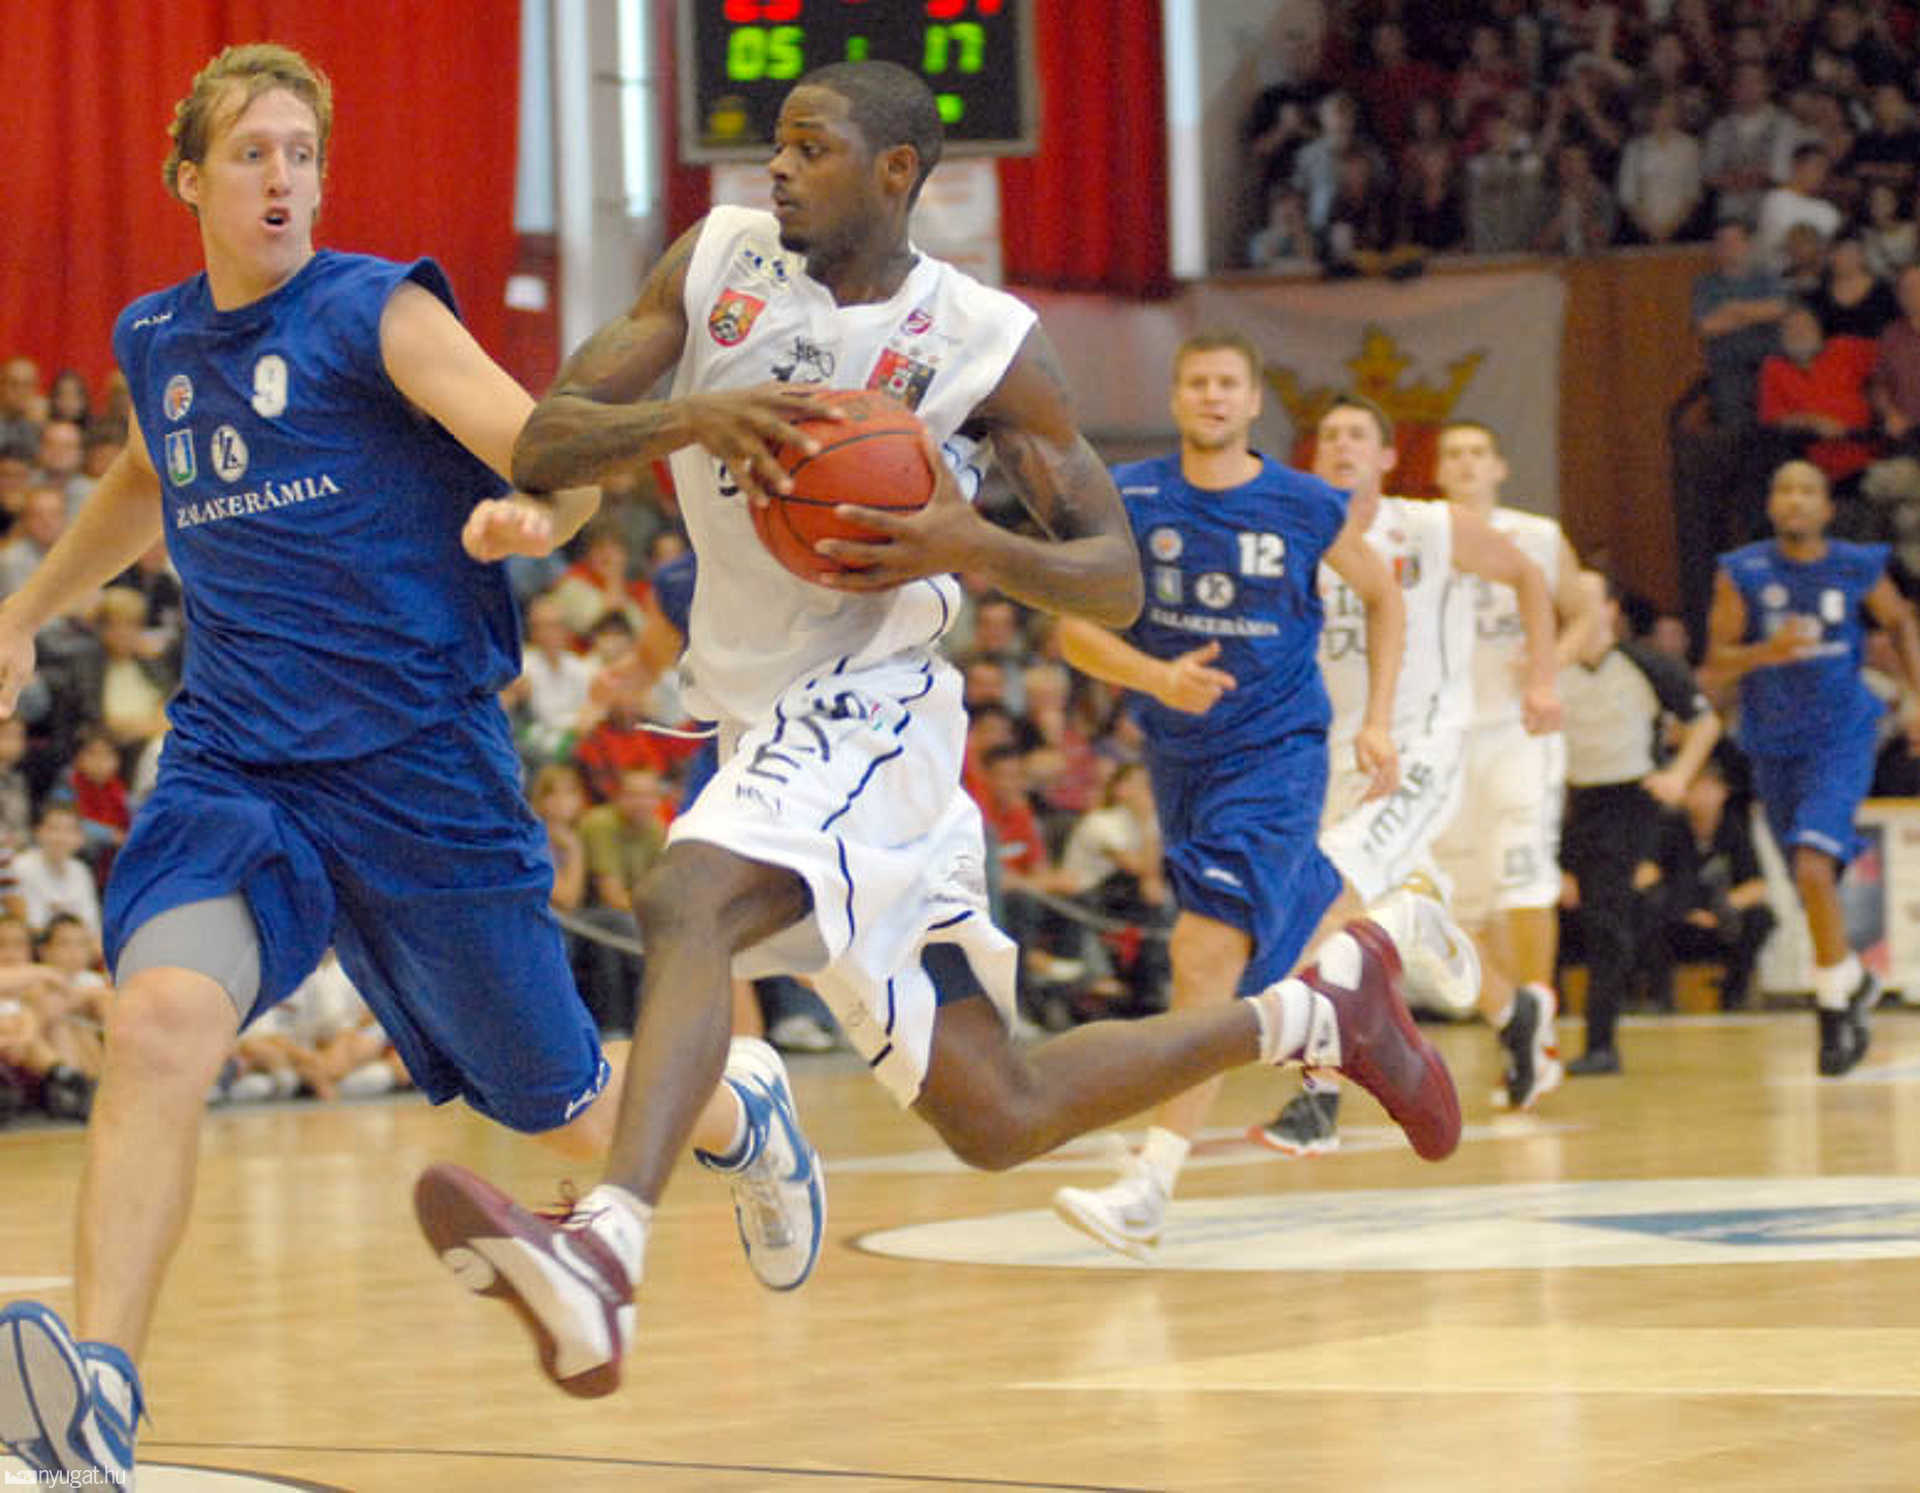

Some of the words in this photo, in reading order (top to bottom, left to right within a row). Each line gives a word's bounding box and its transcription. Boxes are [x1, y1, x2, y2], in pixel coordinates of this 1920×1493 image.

[726, 26, 803, 80] 05
[252, 354, 288, 418] 9
[1237, 532, 1286, 577] 12
